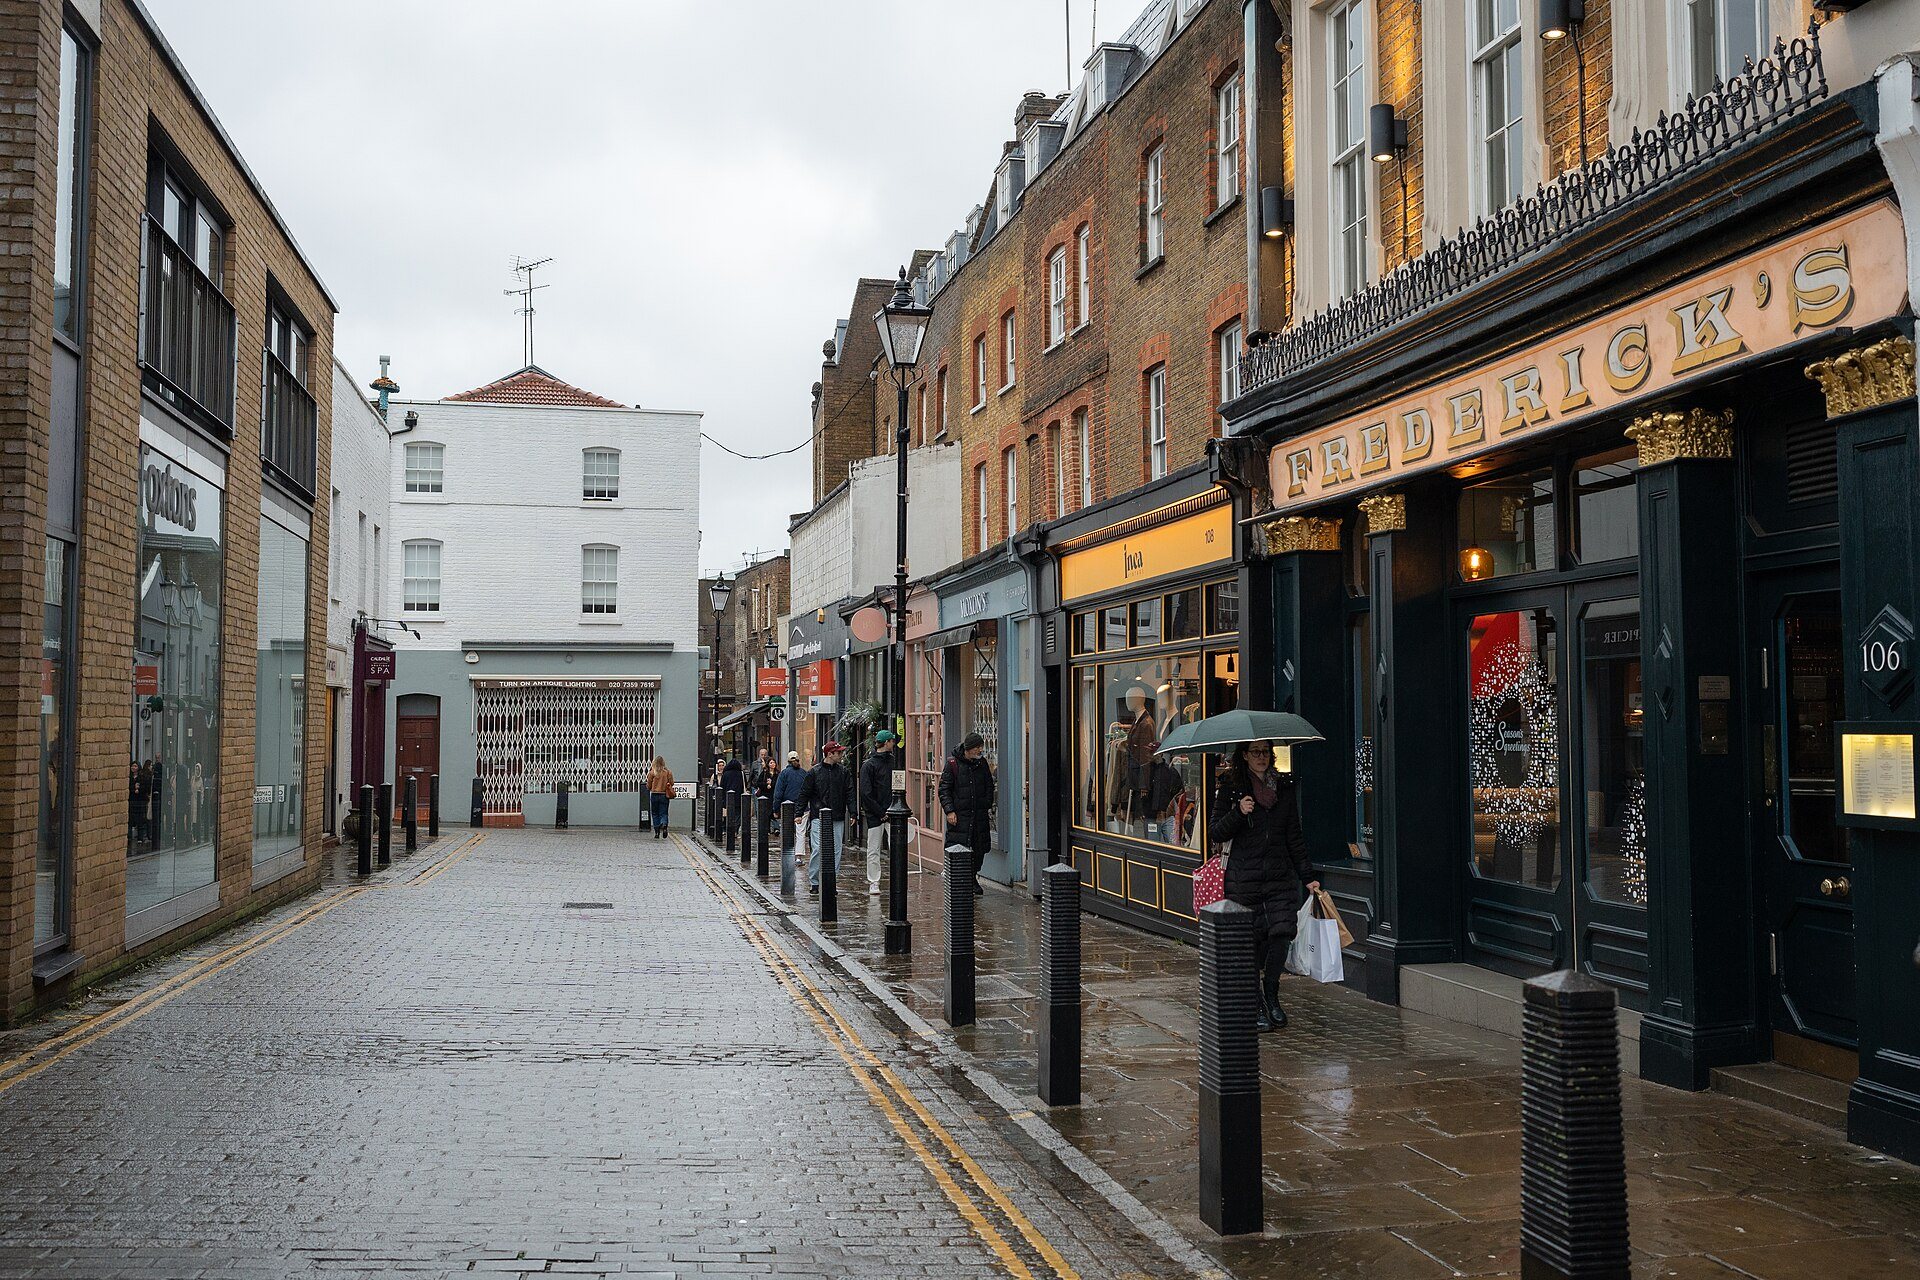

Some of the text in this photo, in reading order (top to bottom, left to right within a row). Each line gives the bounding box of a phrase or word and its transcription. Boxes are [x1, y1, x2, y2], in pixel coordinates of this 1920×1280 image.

[1286, 240, 1855, 498] FREDERICK'S
[1204, 529, 1215, 544] 108
[1862, 641, 1901, 672] 106
[1495, 721, 1524, 750] Season's
[1504, 741, 1531, 756] greetings
